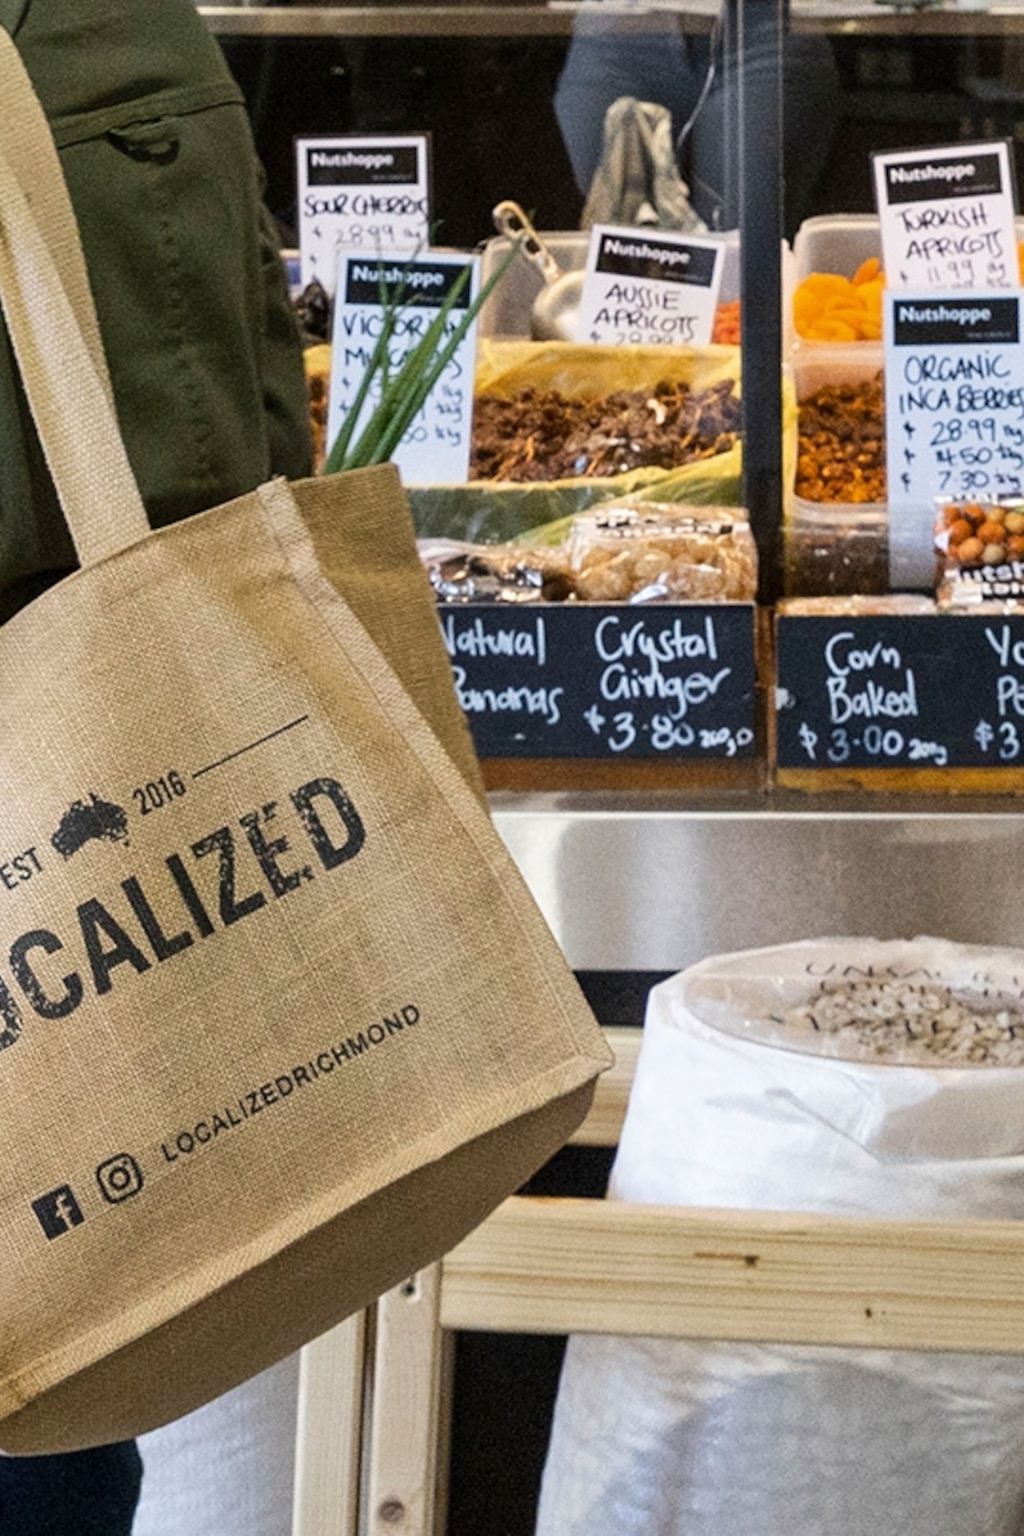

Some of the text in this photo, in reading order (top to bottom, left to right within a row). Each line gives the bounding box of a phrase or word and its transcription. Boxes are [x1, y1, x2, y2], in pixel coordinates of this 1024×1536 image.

[311, 151, 395, 169] Nutshoppe
[889, 163, 976, 184] Nutshoppe
[896, 202, 988, 233] TURKISH
[603, 238, 691, 266] Nutshoppe
[905, 228, 1004, 260] APRICOTS
[604, 282, 681, 311] AUSSIE
[593, 307, 699, 342] APRICOTS
[898, 305, 993, 325] Nutshoppe
[903, 351, 1012, 385] ORGANIC
[898, 385, 952, 414] INCA
[594, 615, 719, 672] Crystal
[825, 631, 901, 676] Corn
[599, 663, 731, 720] Ginger
[827, 668, 919, 724] Baked
[132, 770, 187, 815] 2016
[160, 1004, 420, 1163] LOCALIZEDRICHMOND
